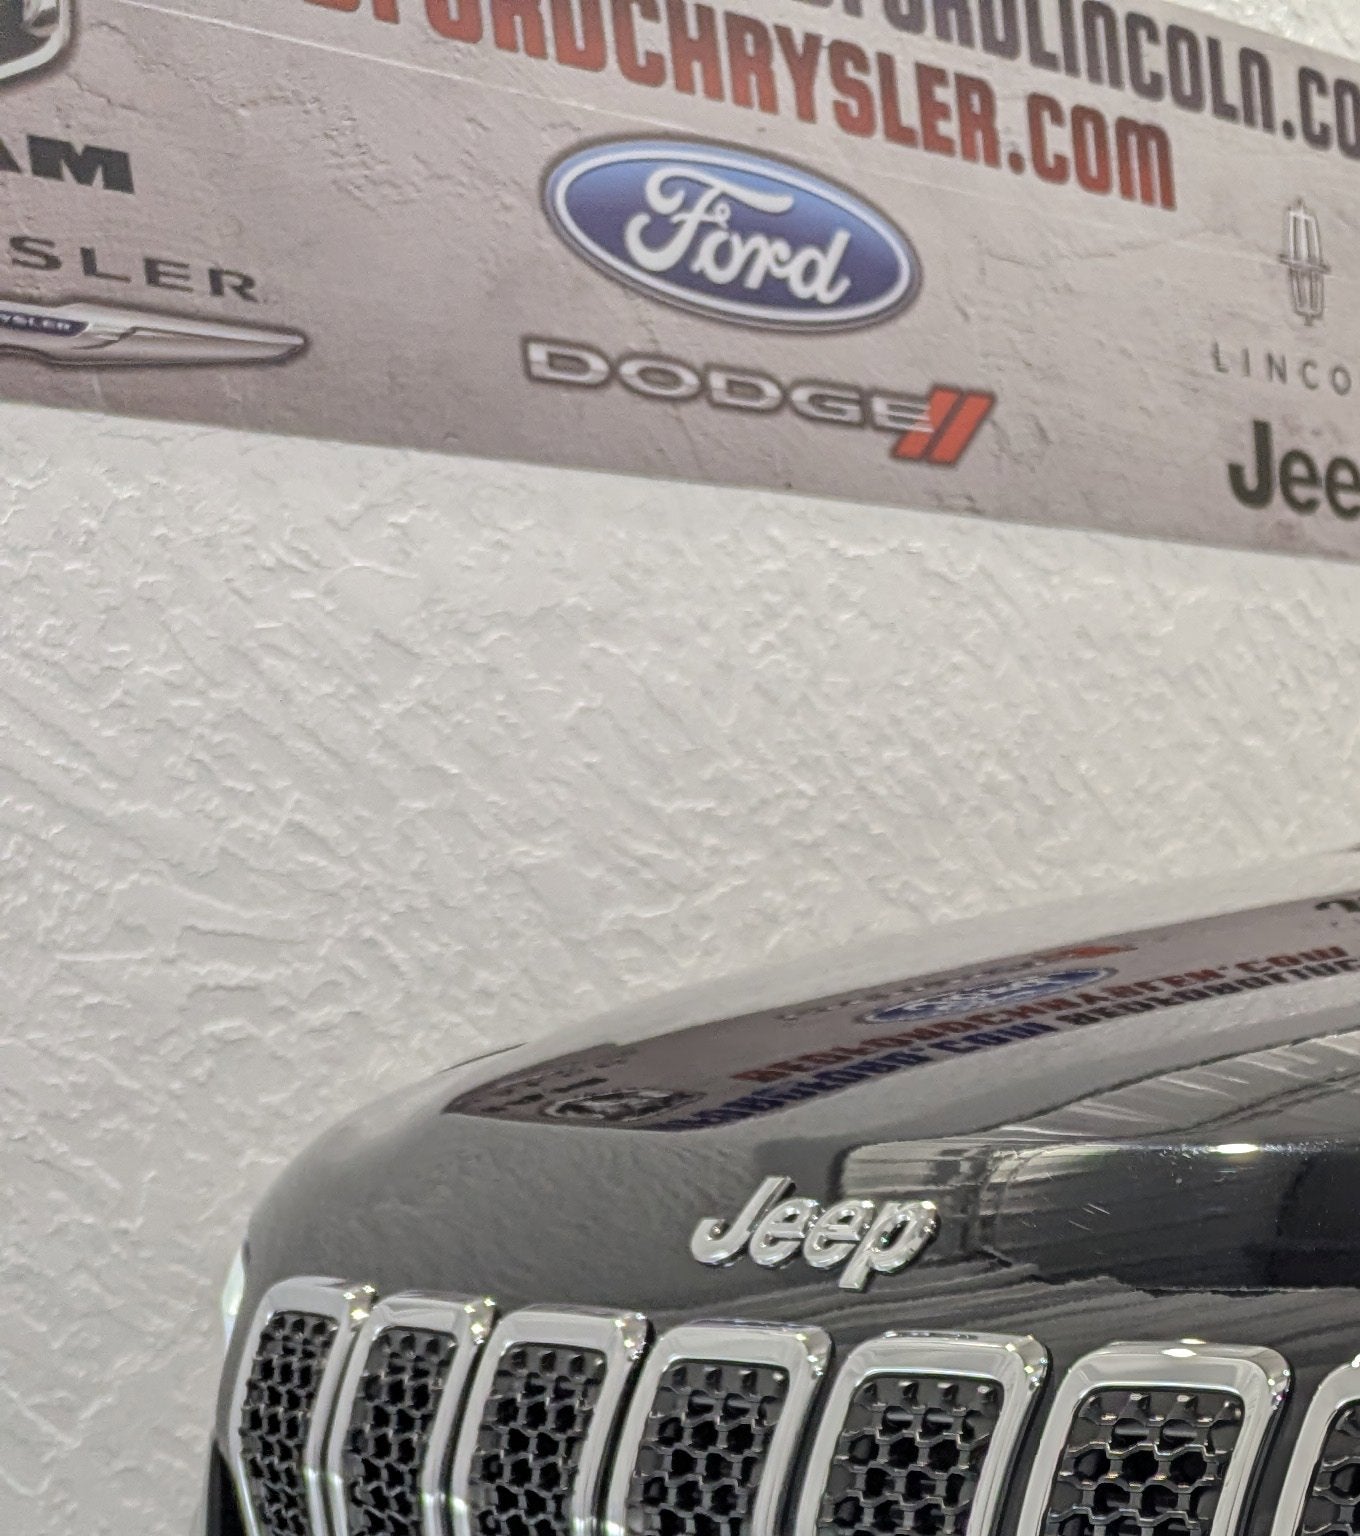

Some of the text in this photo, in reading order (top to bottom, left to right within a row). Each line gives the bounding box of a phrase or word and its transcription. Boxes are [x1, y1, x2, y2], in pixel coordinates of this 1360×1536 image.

[305, 0, 1177, 211] RDCHRYSLER.COM
[625, 166, 851, 305] Ford
[522, 336, 936, 435] DODGE
[690, 1175, 941, 1293] Jeep
